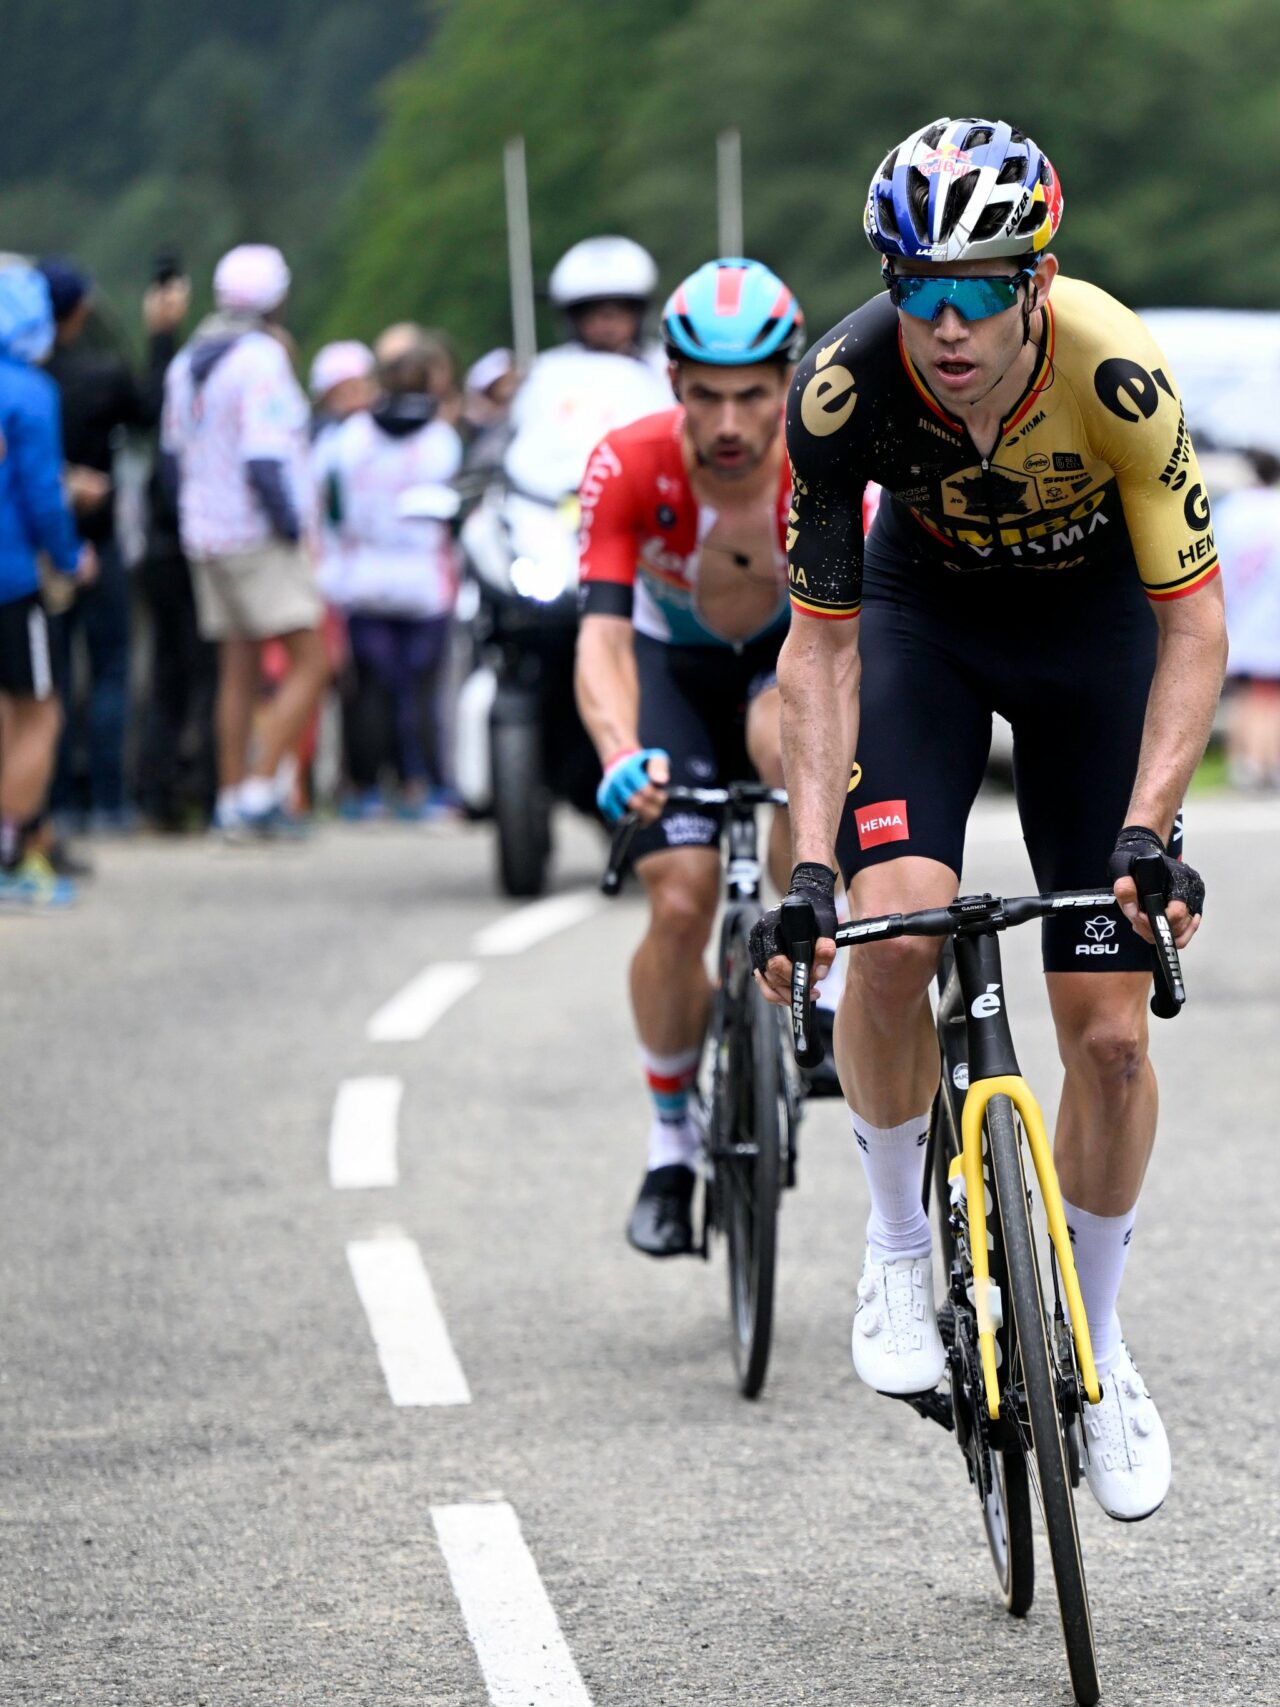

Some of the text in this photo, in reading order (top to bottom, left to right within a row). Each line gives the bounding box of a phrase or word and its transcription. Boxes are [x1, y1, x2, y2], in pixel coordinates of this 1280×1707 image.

[918, 161, 970, 177] Red Bull
[1005, 190, 1030, 238] LAZER
[916, 248, 948, 256] LAZER
[917, 417, 963, 448] JUMBO
[1018, 410, 1047, 436] VISMA
[968, 511, 1110, 557] VISMA
[860, 815, 903, 834] HEMA
[961, 904, 987, 912] GARMIN
[1075, 943, 1120, 956] AGU
[1155, 915, 1185, 986] SRAM
[793, 961, 807, 1036] SRAM
